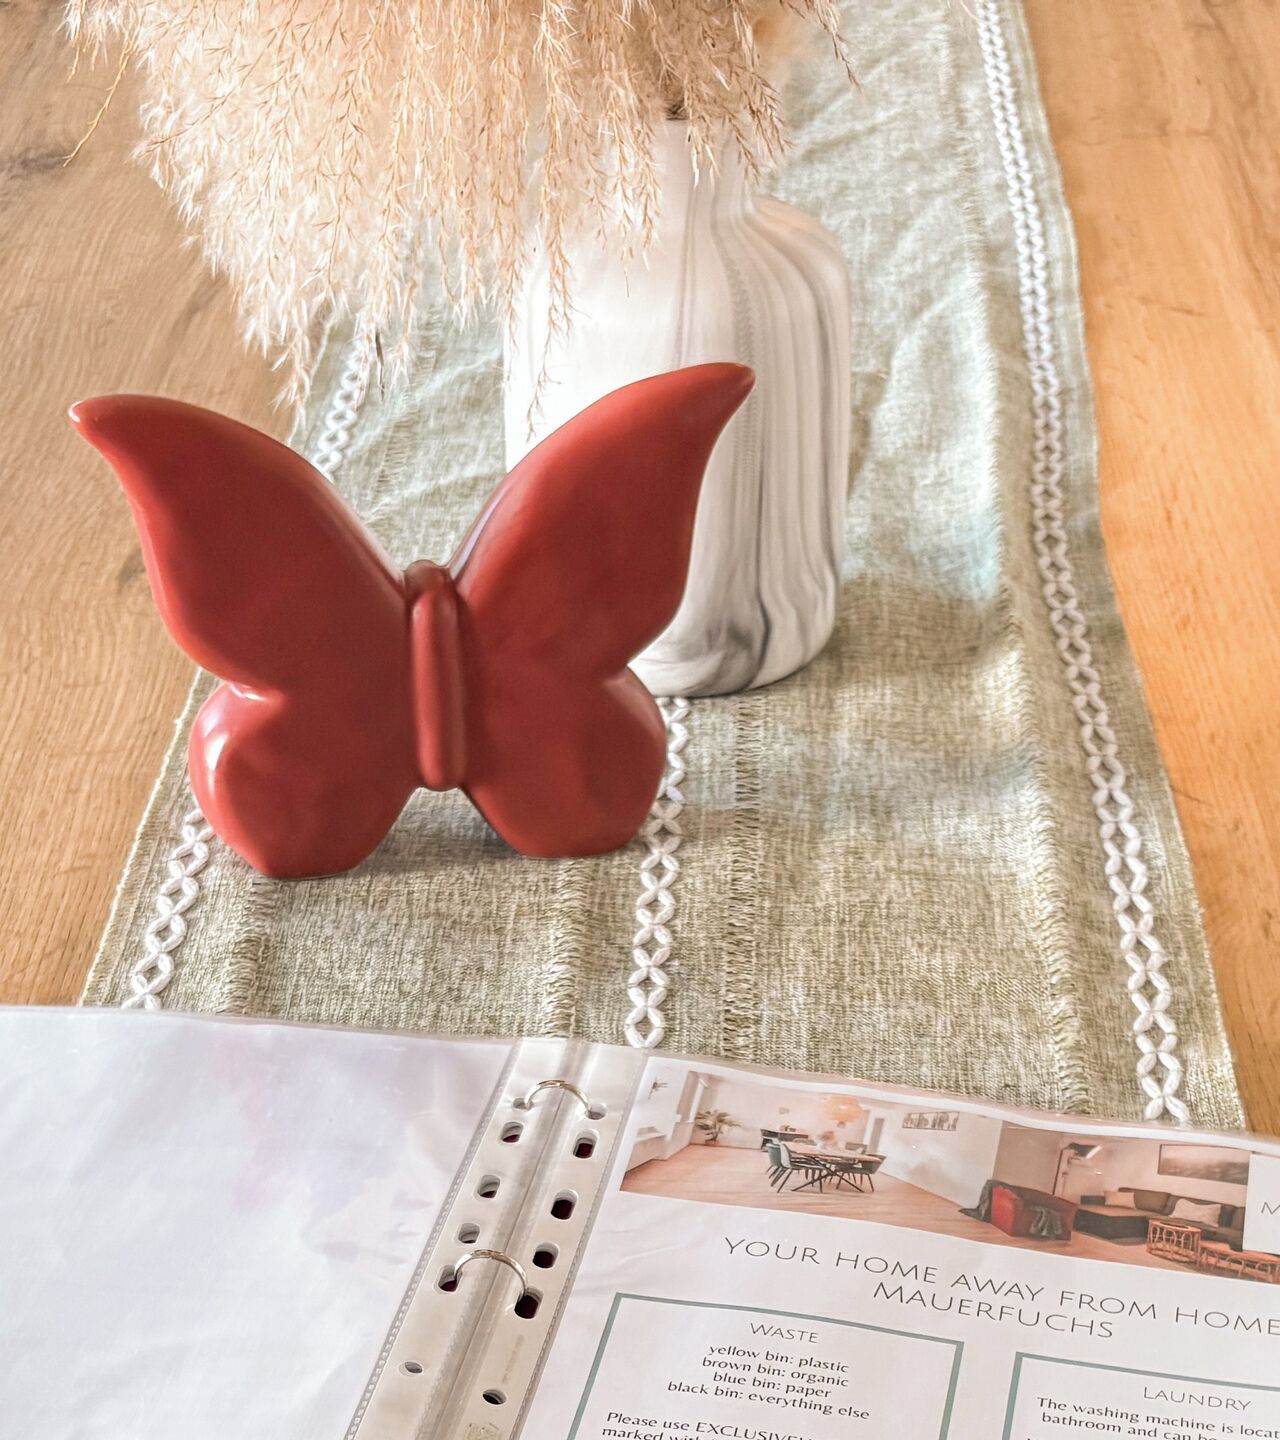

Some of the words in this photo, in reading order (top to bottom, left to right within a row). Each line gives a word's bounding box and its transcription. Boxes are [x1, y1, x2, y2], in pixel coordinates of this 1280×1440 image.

[724, 1236, 821, 1265] YOUR
[835, 1250, 939, 1283] HOME
[949, 1273, 1046, 1302] AWAY
[1059, 1290, 1157, 1320] FROM
[1174, 1306, 1280, 1336] HOME
[872, 1280, 1114, 1339] MAUERFUCHS
[750, 1322, 818, 1344] WASTE
[702, 1356, 752, 1372] brown
[756, 1362, 787, 1378] bin:
[790, 1370, 847, 1388] organic
[709, 1344, 759, 1359] yellow
[764, 1350, 795, 1364] bin:
[798, 1356, 847, 1374] plastic
[712, 1370, 748, 1386] blue
[751, 1375, 782, 1391] bin:
[784, 1384, 831, 1398] paper
[1143, 1386, 1252, 1412] LAUNDRY
[667, 1380, 709, 1396] black
[713, 1384, 745, 1399] bin:
[747, 1392, 834, 1416] everything
[837, 1406, 870, 1419] else
[606, 1411, 659, 1428] Please
[662, 1420, 691, 1432] use
[1039, 1396, 1068, 1412] The
[1072, 1404, 1140, 1424] washing
[1145, 1415, 1216, 1432] machine
[1221, 1424, 1235, 1434] is
[1041, 1410, 1122, 1434] bathroom
[1127, 1426, 1158, 1438] and
